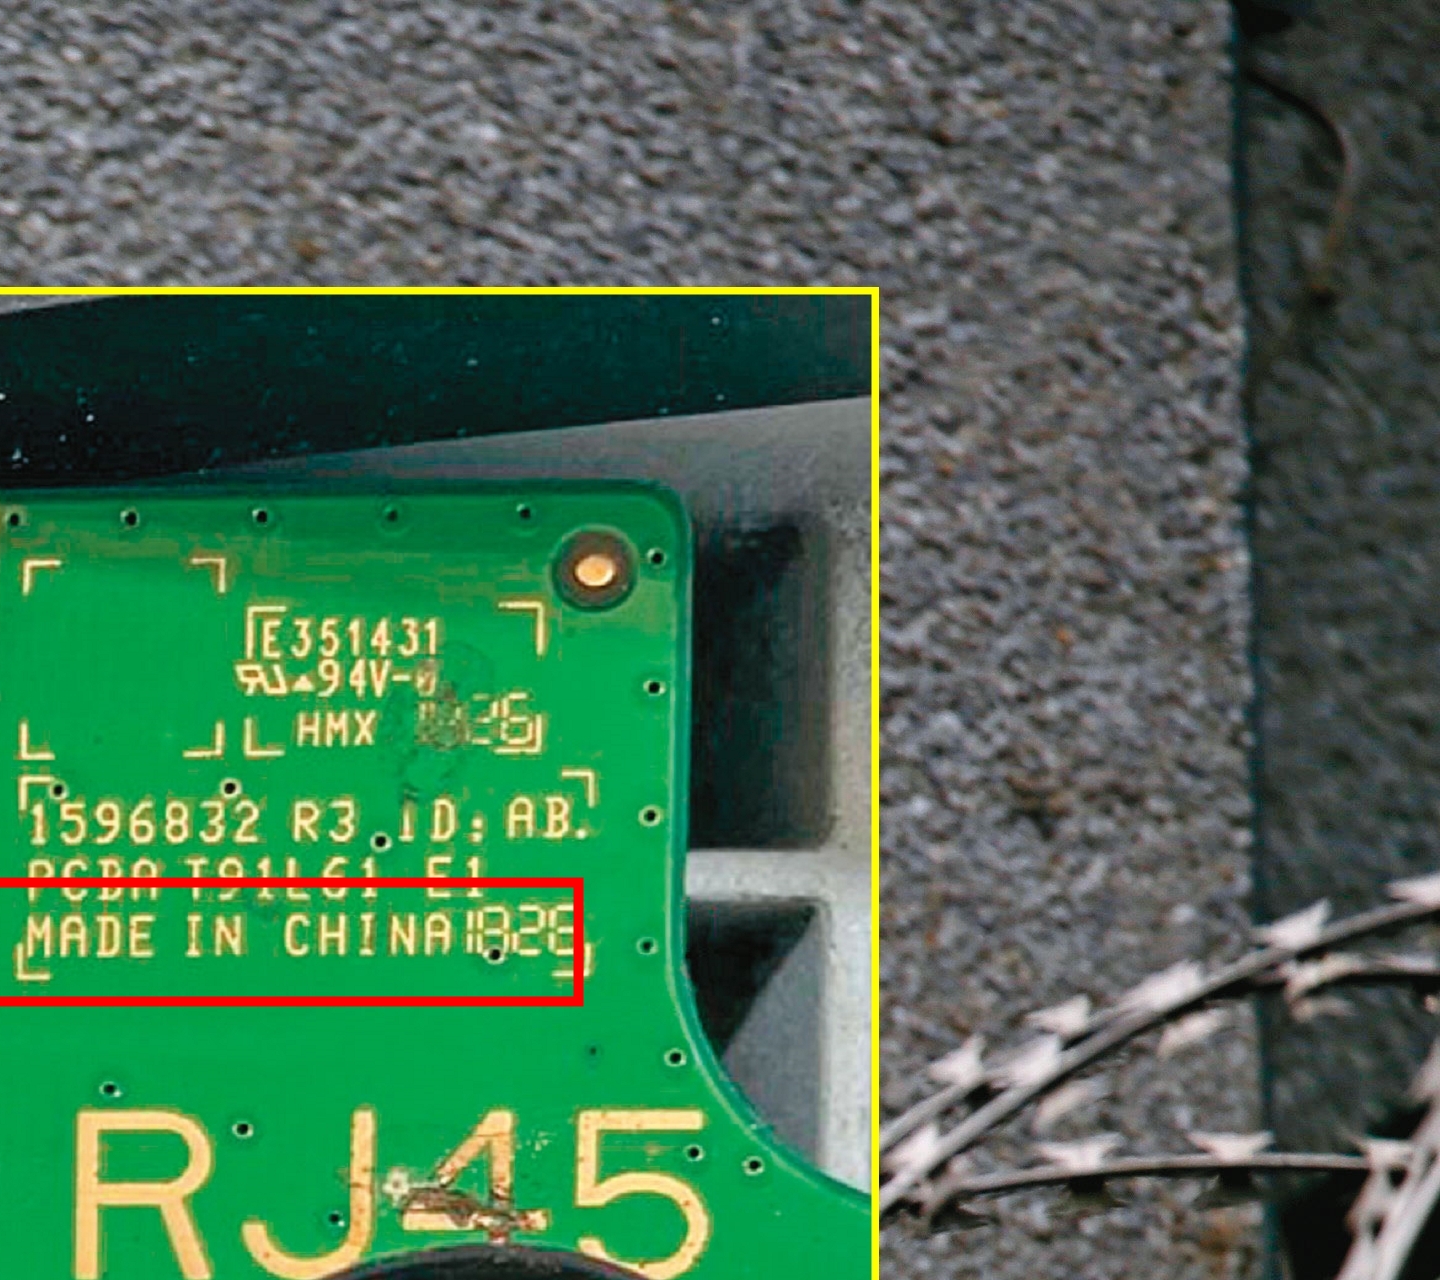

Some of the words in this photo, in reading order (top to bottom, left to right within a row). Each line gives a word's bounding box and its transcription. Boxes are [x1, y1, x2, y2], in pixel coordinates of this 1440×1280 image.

[261, 616, 439, 660] E351431
[295, 709, 378, 747] HMX
[26, 798, 262, 846] 1596832
[291, 797, 358, 844] R3
[26, 856, 161, 902] PCBA
[425, 855, 485, 899] E1
[26, 913, 157, 959] MADE
[184, 913, 243, 959] IN
